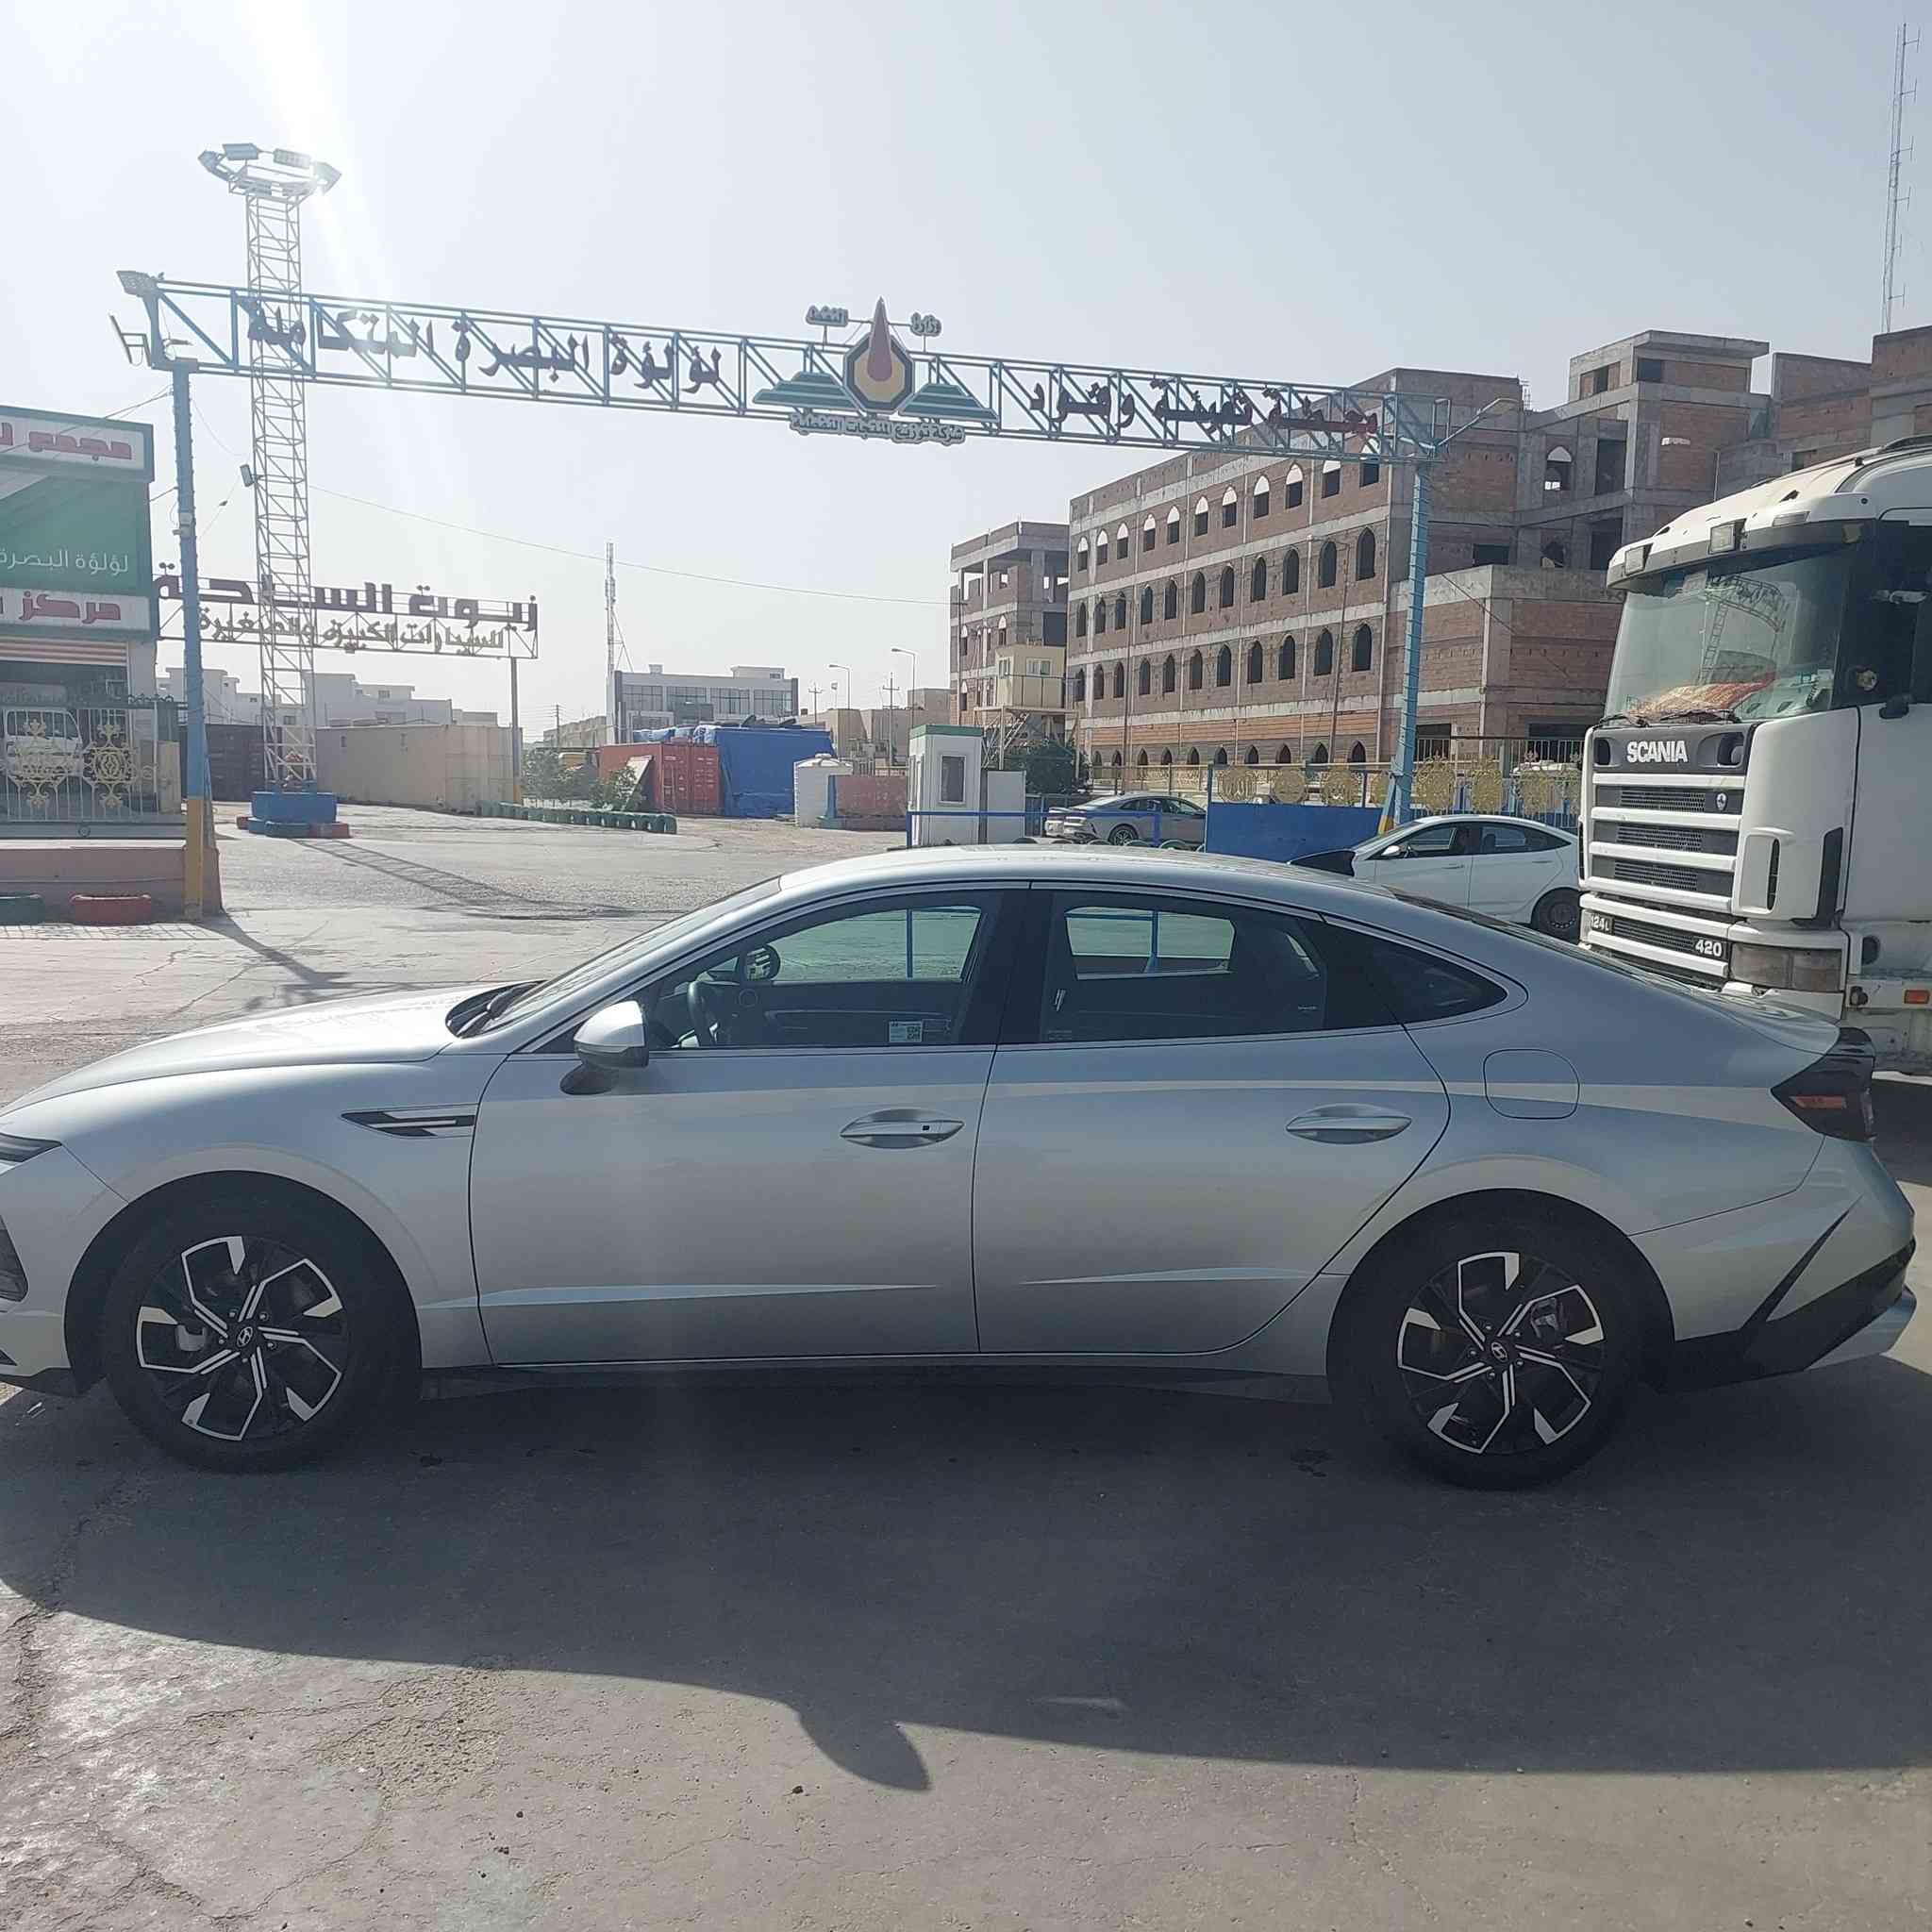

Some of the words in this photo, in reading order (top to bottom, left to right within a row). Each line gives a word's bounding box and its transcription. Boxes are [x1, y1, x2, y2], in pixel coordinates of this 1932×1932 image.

[806, 306, 848, 326] النفط
[451, 319, 590, 383] البصرة
[610, 332, 723, 394] لؤلؤة
[1030, 382, 1135, 428] وقود
[845, 418, 892, 440] المنتجات
[893, 421, 932, 443] توزيع
[933, 423, 965, 445] شركة
[28, 431, 132, 461] مجمع
[0, 546, 69, 571] البصرة
[75, 551, 129, 576] لؤلؤة
[18, 591, 121, 624] مركز
[1626, 741, 1688, 763] SCANIA
[1695, 939, 1724, 958] 420
